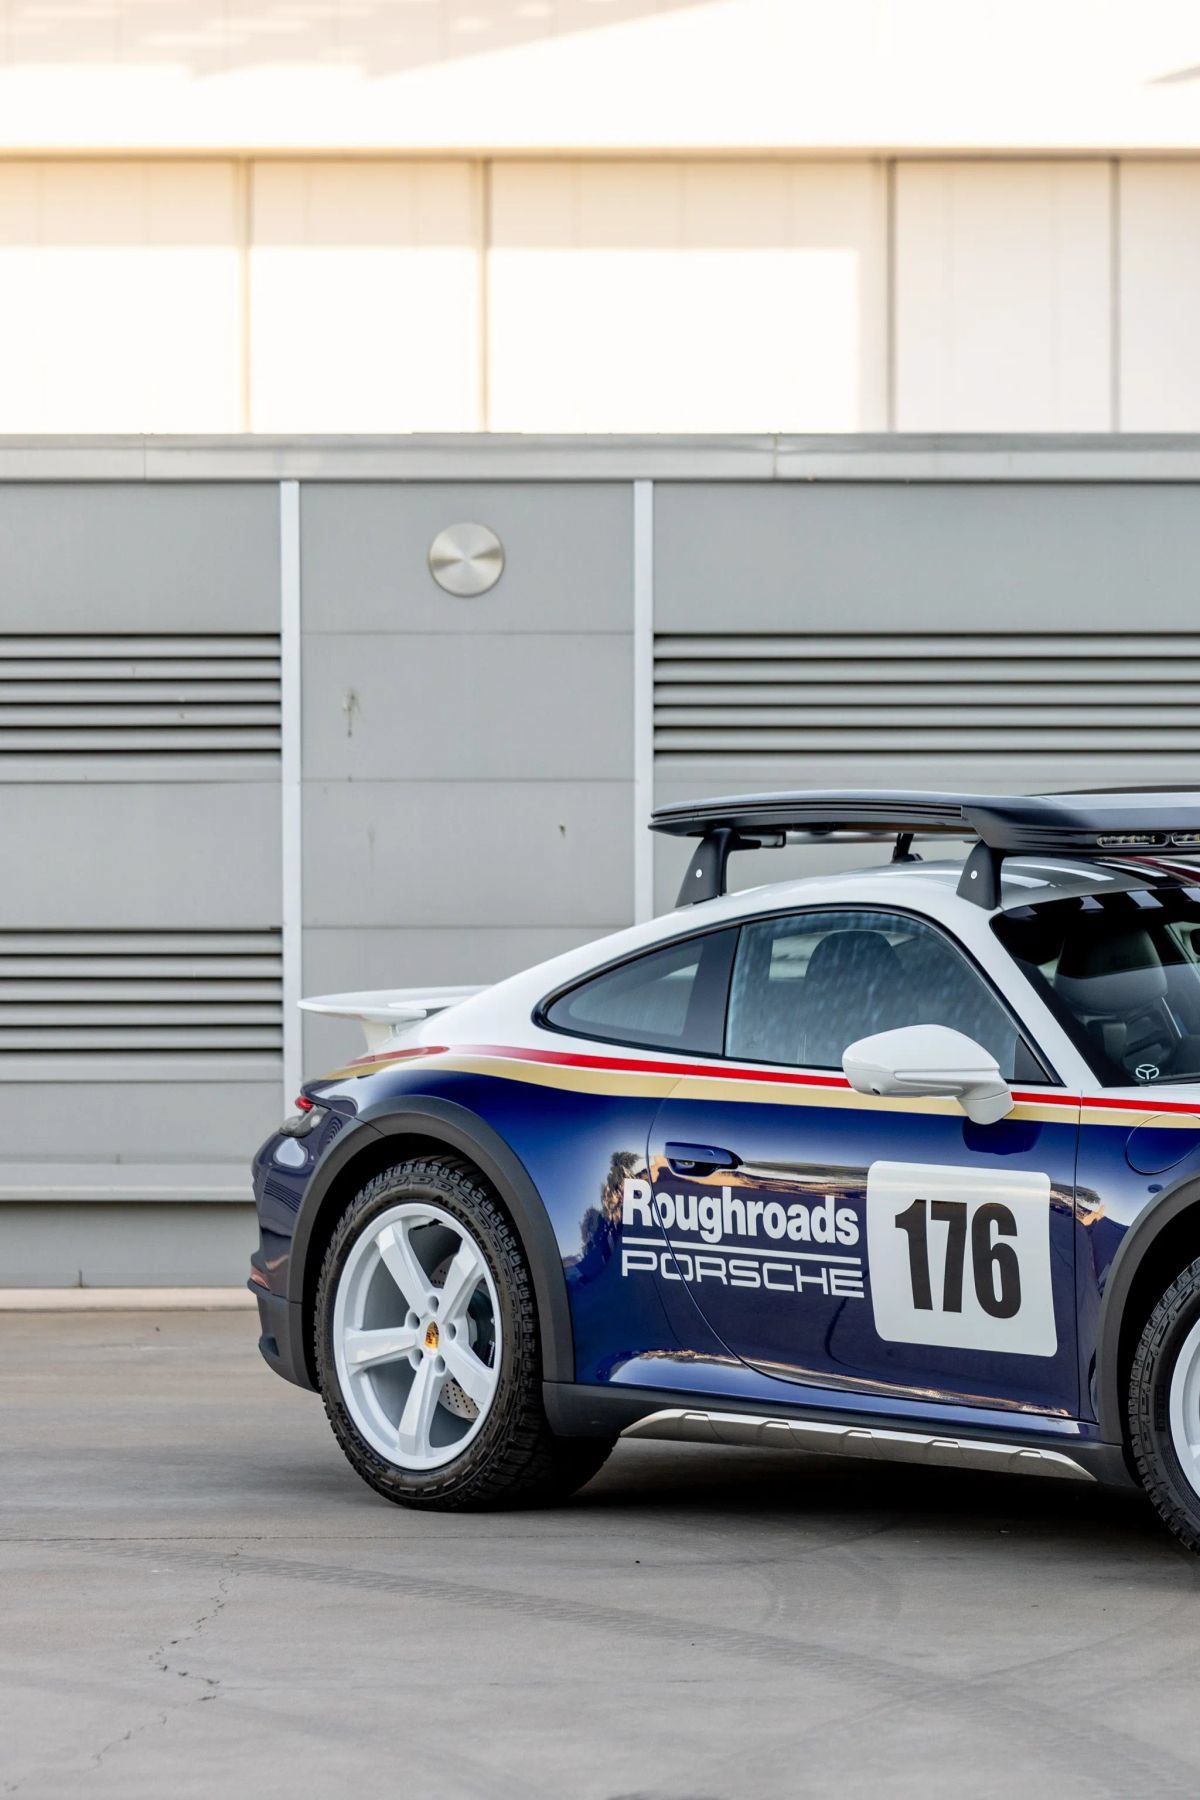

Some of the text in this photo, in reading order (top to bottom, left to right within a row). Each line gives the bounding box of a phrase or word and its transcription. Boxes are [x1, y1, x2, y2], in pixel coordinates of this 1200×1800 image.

[623, 1179, 860, 1246] Roughroads
[622, 1250, 864, 1298] PORSCHE
[895, 1198, 1022, 1320] 176
[335, 1402, 391, 1473] SCORPION
